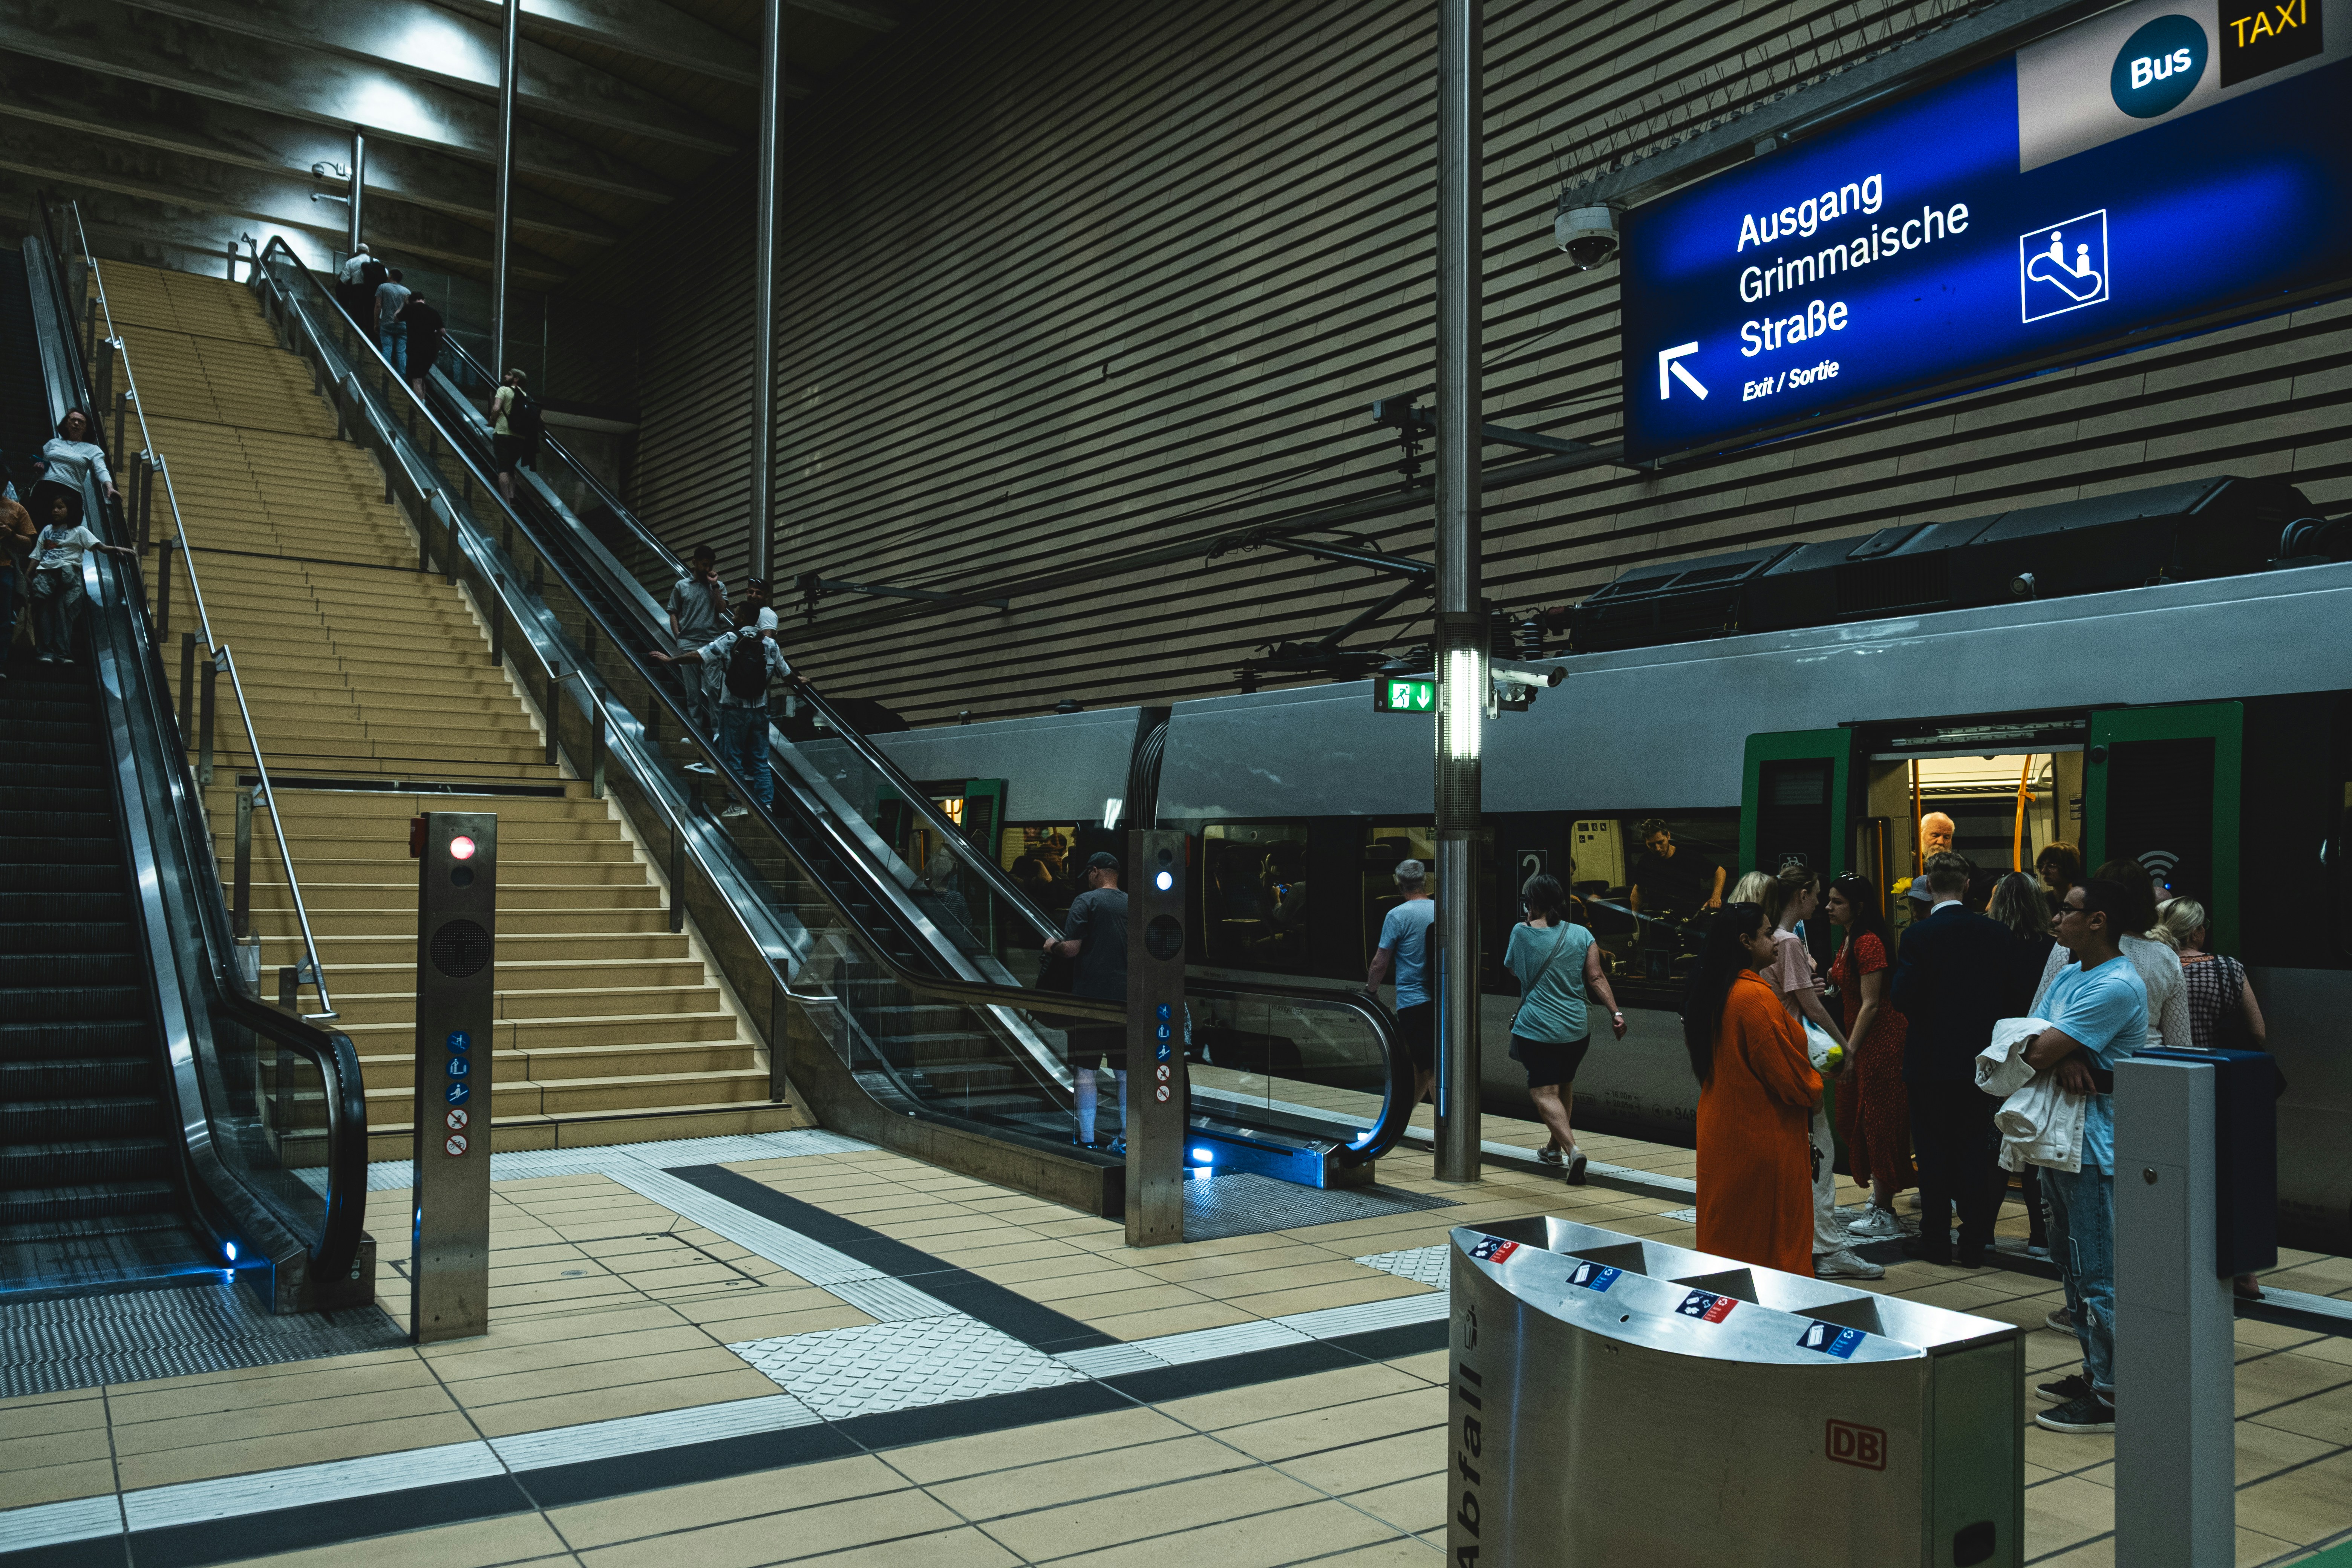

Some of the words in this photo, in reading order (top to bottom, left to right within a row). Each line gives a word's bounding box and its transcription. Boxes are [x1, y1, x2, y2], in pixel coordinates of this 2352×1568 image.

[2230, 0, 2306, 47] TAXI
[2131, 48, 2192, 90] Bus
[1736, 173, 1883, 253] Ausgang
[1740, 203, 1969, 303] Grimmaische
[1740, 299, 1848, 357] Straße
[1742, 376, 1775, 402] Exit
[1788, 359, 1839, 389] Sortie
[1522, 854, 1540, 894] 2
[1457, 1362, 1483, 1568] Abfall
[1833, 1426, 1879, 1462] DB
